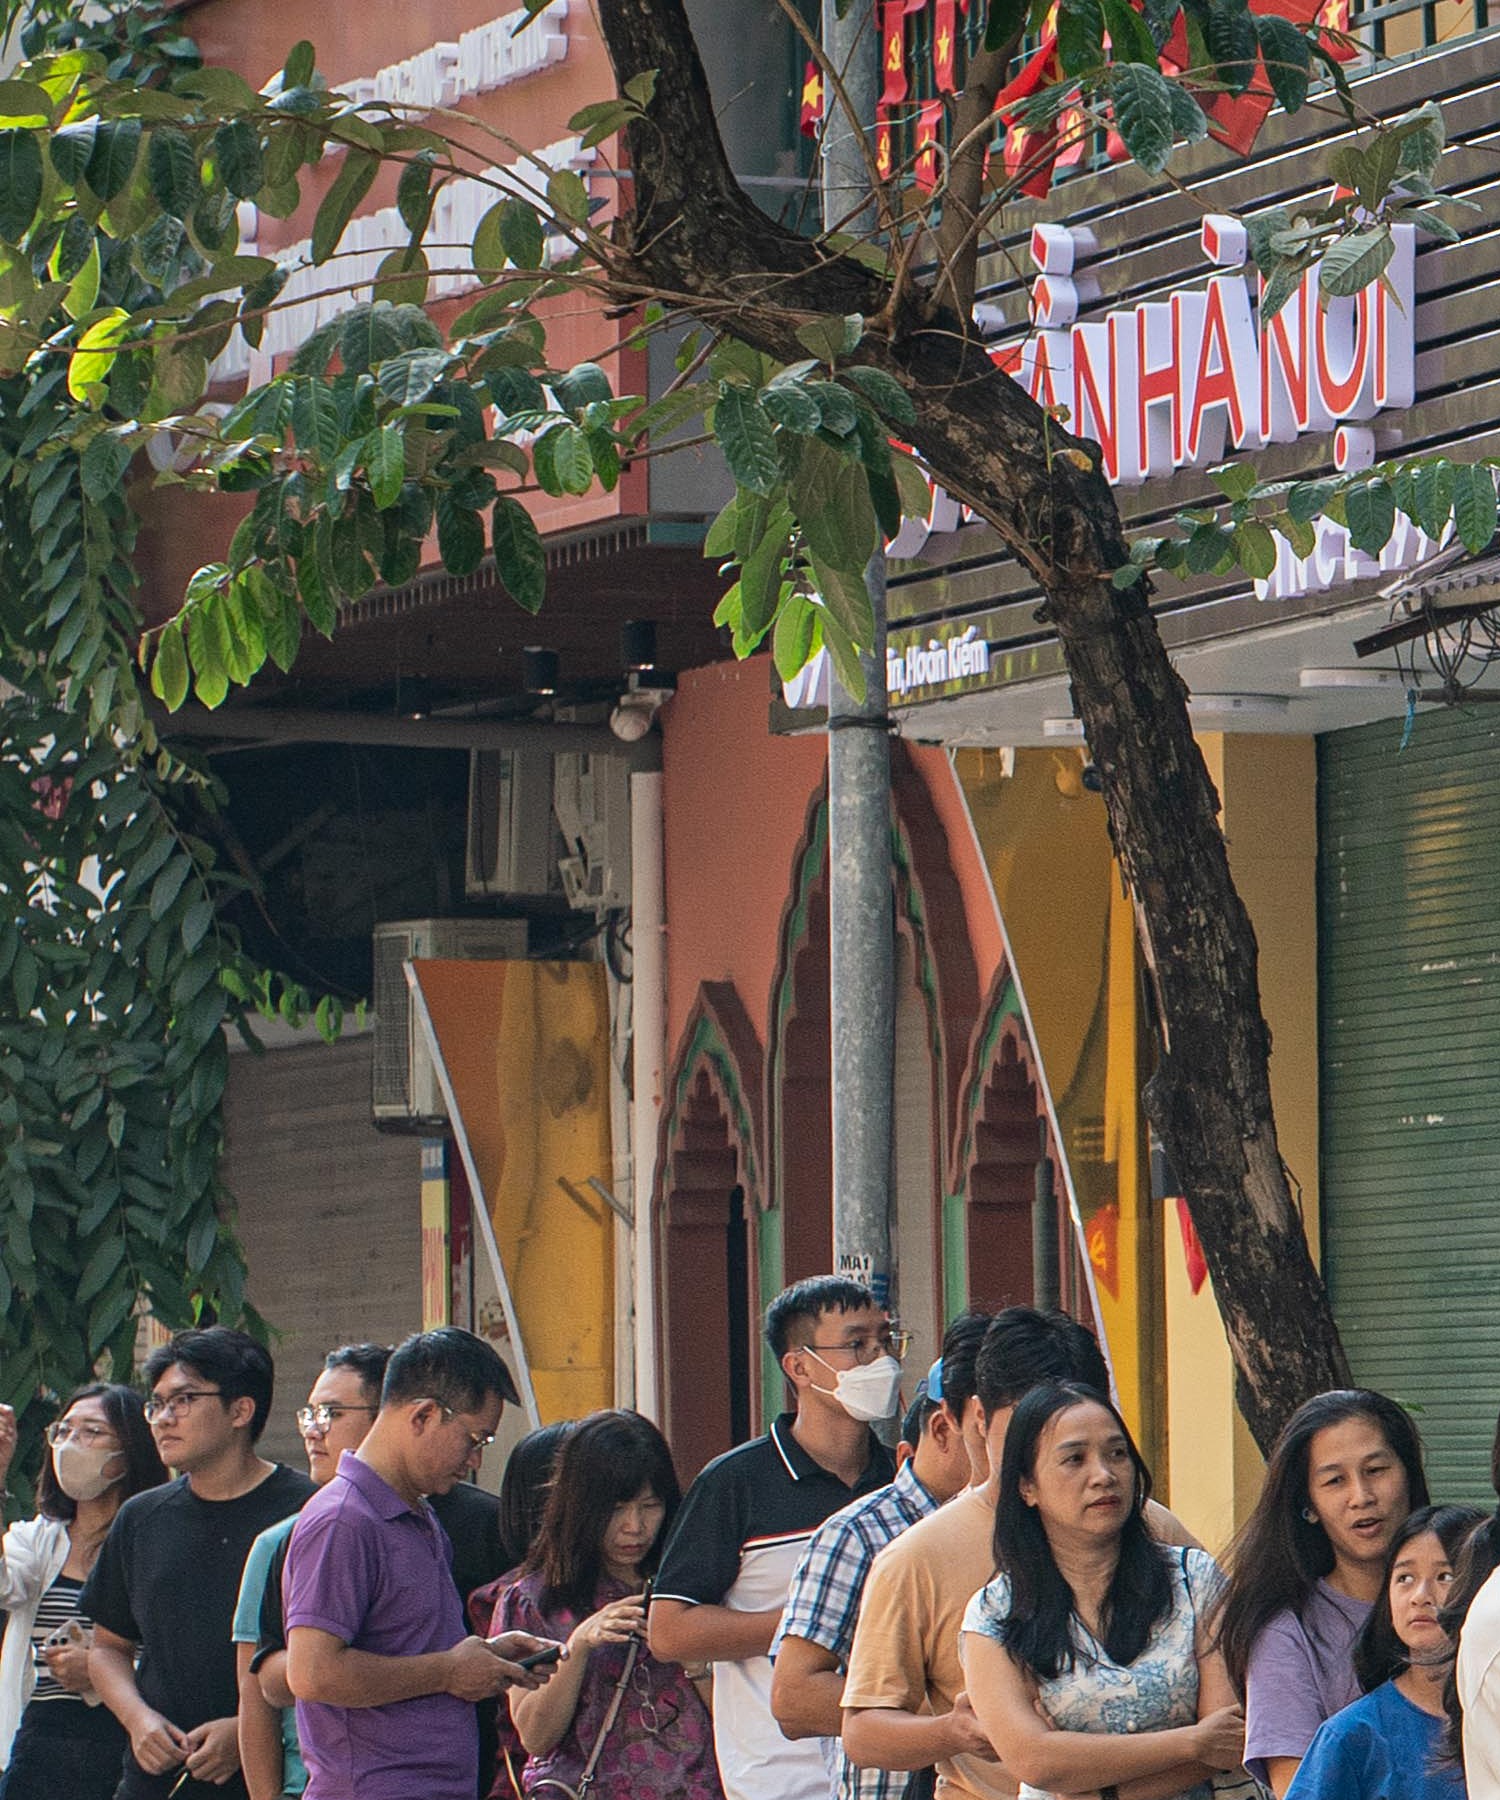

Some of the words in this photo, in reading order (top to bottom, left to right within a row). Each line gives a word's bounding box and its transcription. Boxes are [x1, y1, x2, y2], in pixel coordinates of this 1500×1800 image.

[1254, 514, 1380, 601] INCE
[906, 638, 948, 688] Hoàn
[948, 625, 990, 681] Kiếm
